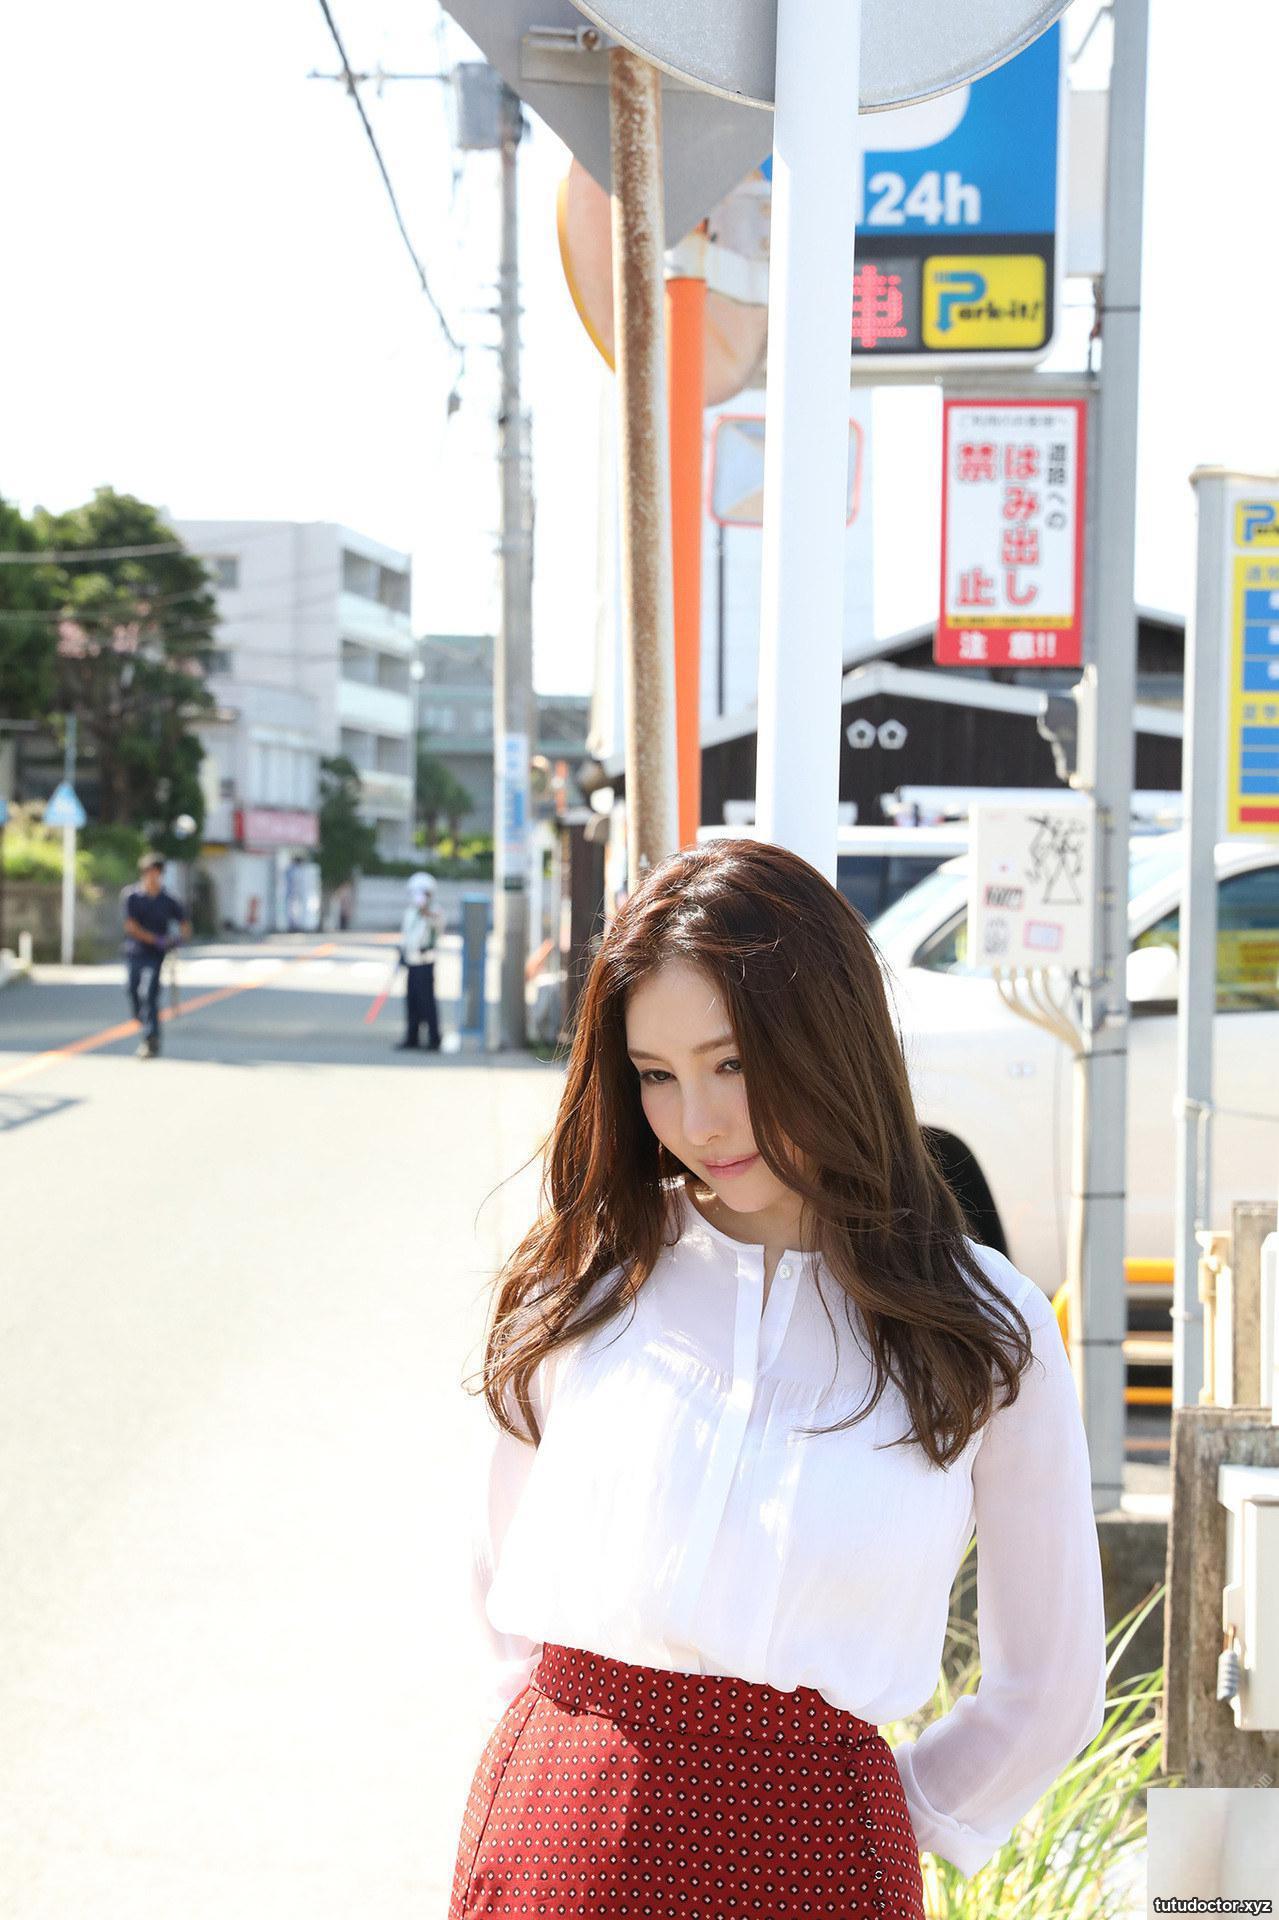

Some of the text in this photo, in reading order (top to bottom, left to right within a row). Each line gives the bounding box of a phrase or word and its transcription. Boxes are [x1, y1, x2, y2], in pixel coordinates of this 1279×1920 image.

[867, 171, 981, 226] 24h
[1002, 443, 1041, 606] はみ出し
